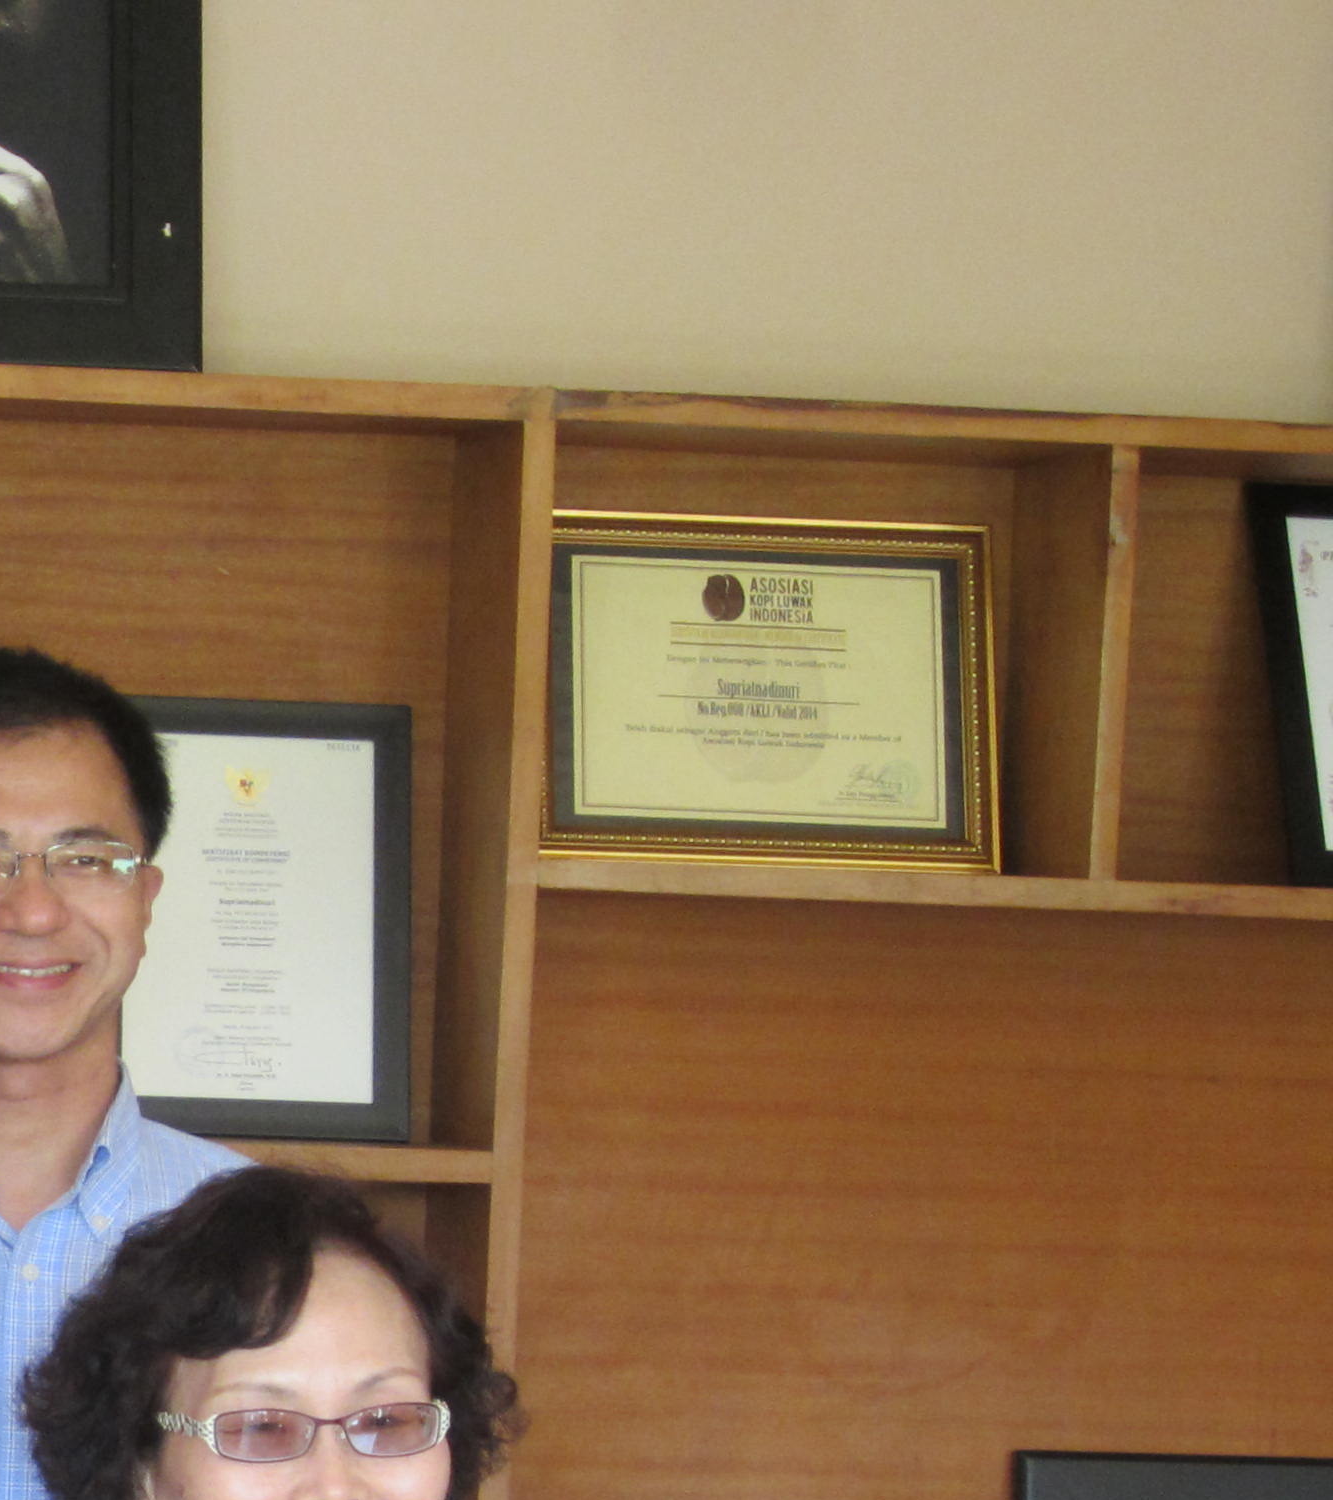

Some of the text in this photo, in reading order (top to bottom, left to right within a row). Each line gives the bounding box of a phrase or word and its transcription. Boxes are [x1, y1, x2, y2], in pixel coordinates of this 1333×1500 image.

[750, 577, 814, 595] ASOSIASI
[750, 595, 814, 609] KOPI LUWAK
[750, 608, 814, 623] INDONESIA
